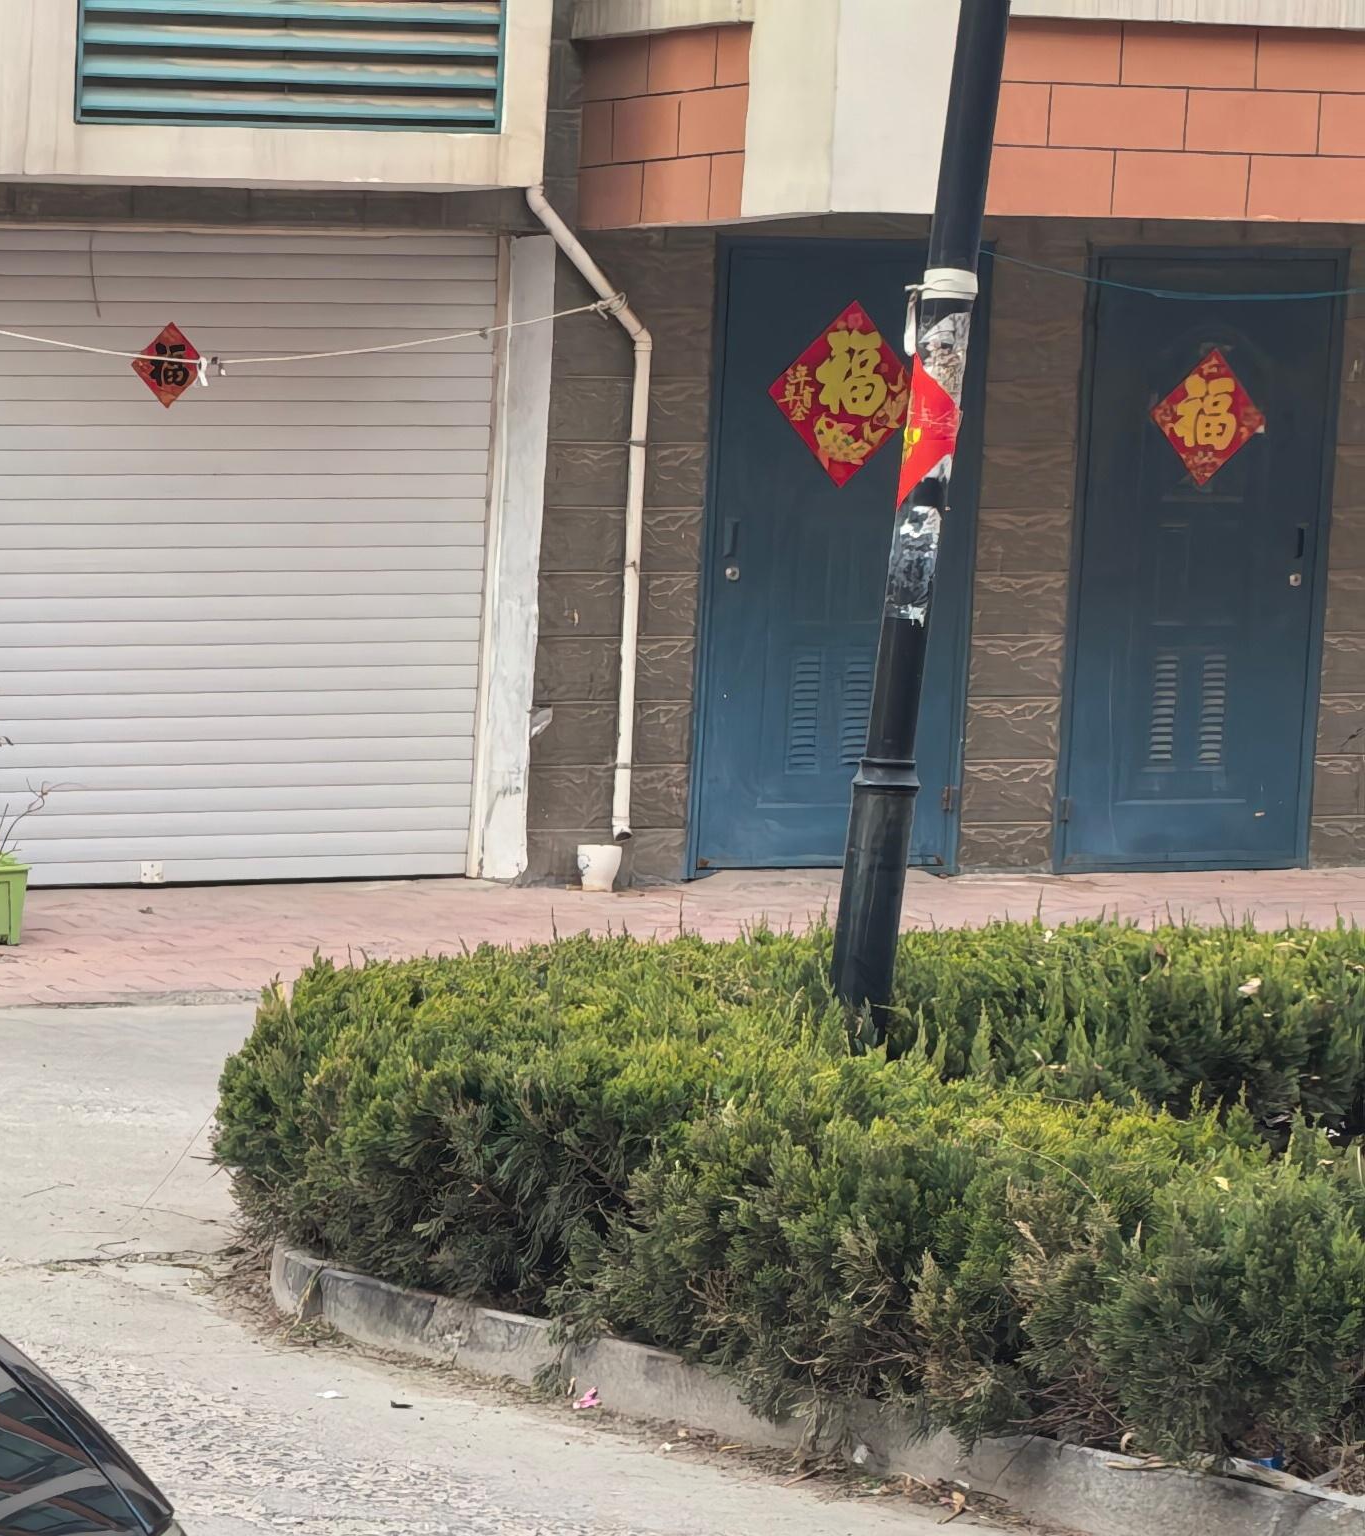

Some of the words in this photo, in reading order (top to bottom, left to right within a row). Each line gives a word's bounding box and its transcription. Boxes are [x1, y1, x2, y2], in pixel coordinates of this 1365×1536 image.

[150, 342, 189, 386] 福
[816, 330, 887, 416] 福
[1174, 374, 1237, 450] 福
